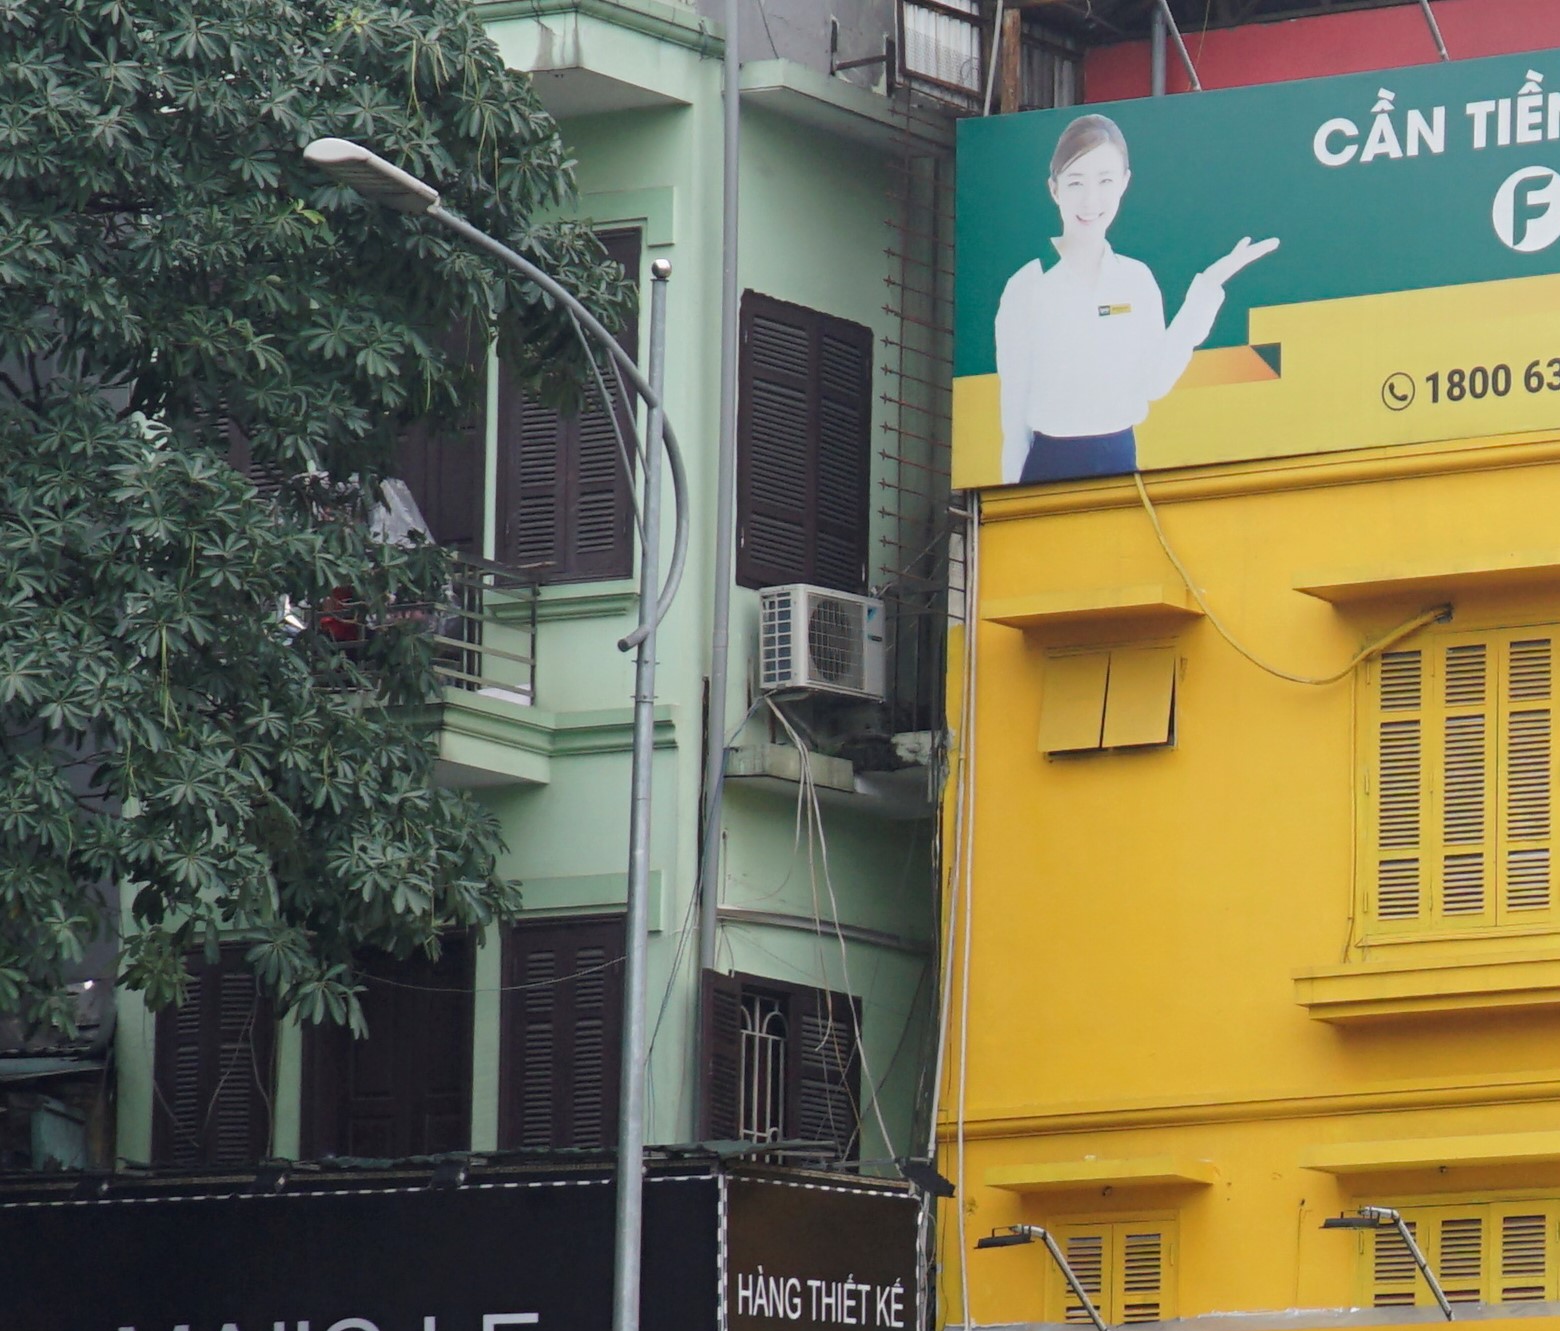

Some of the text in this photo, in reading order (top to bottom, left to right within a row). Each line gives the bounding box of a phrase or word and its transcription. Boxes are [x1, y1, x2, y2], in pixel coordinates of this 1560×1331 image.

[1313, 88, 1446, 167] CẦN
[1425, 363, 1512, 404] 1800
[738, 1265, 905, 1329] HÀNG THIẾT KẾ
